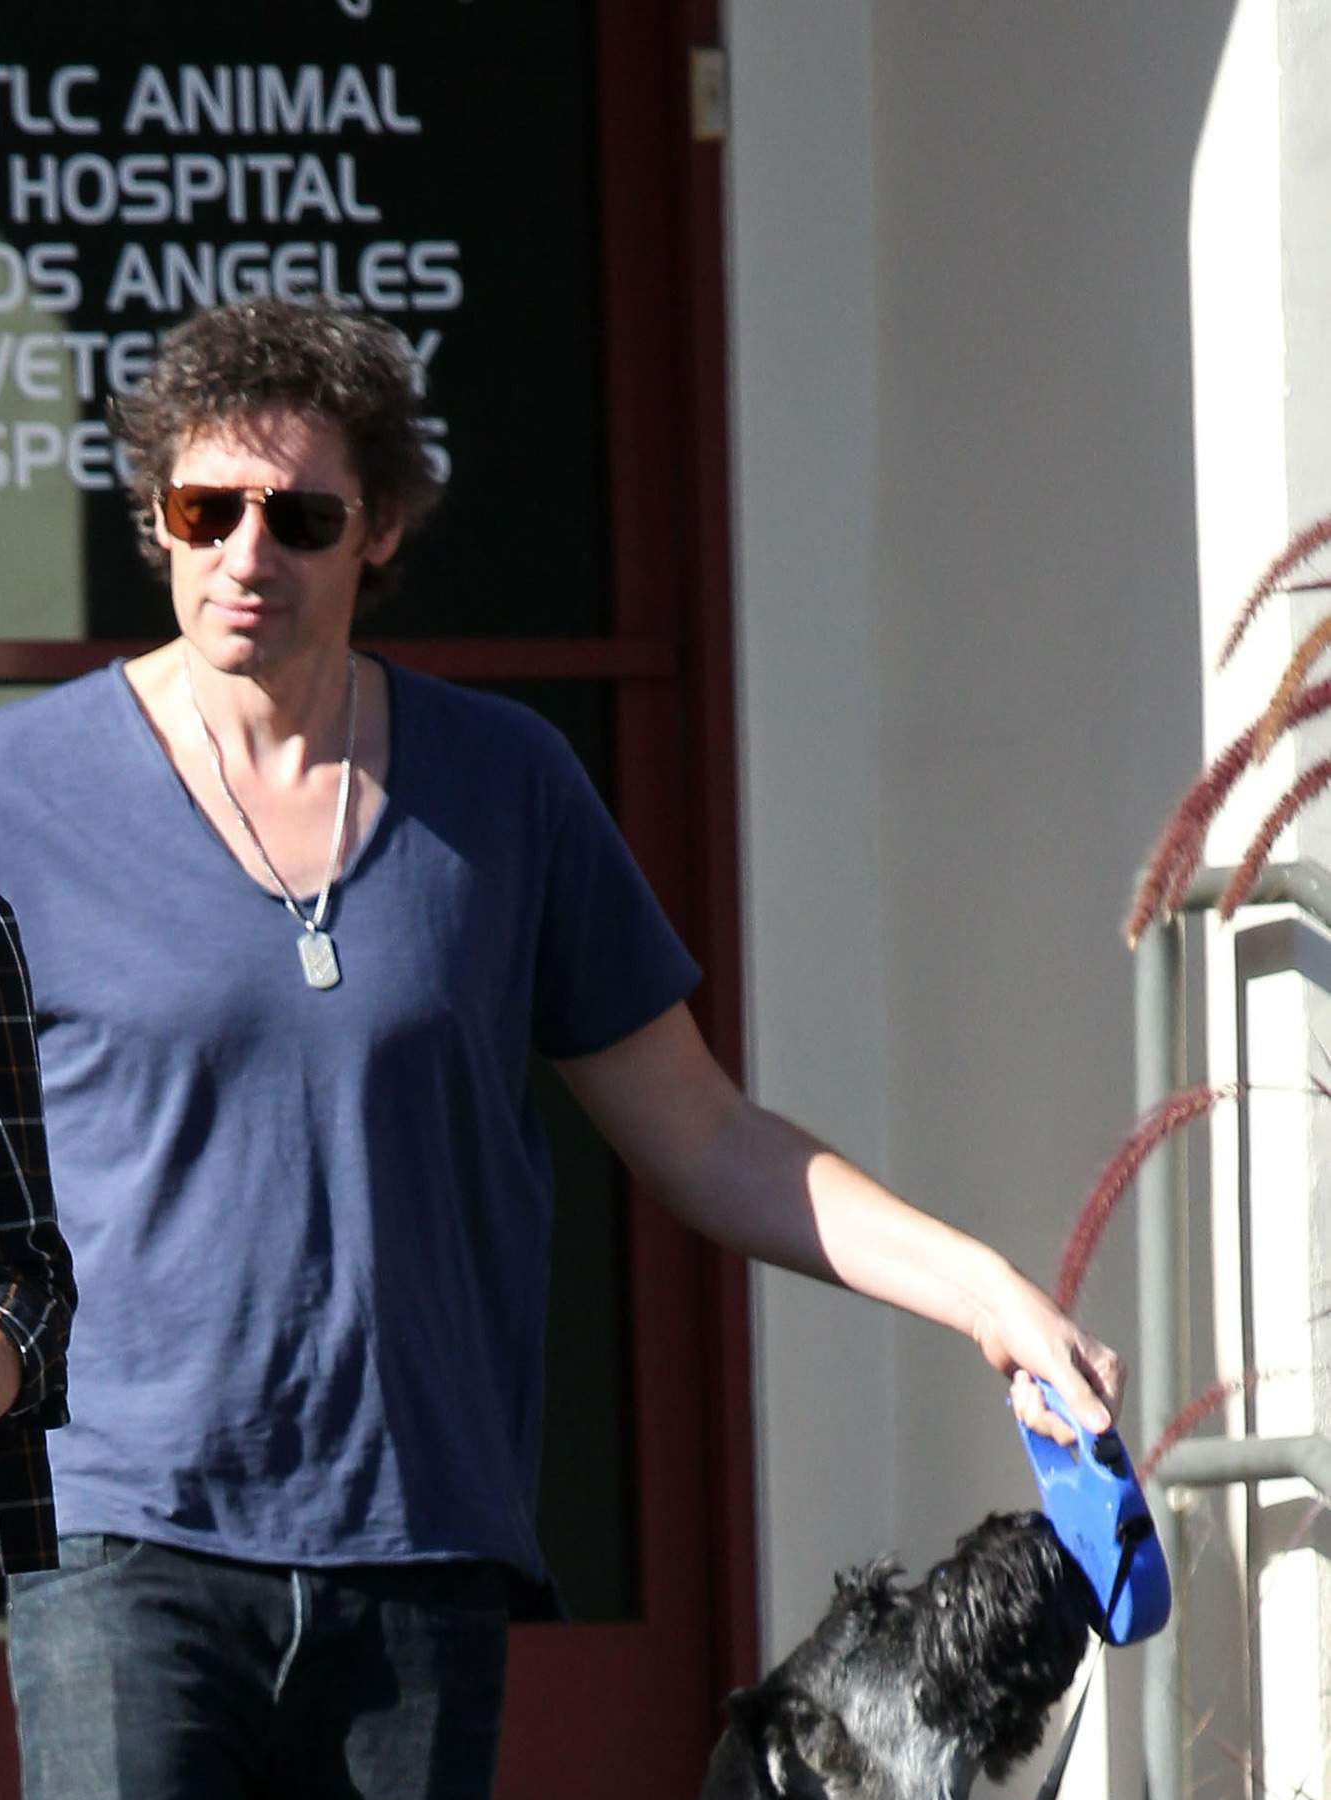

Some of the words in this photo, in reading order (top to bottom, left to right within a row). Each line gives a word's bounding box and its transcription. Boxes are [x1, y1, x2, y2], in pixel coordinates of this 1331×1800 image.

[124, 64, 421, 134] ANIMAL
[7, 153, 382, 225] HOSPITAL
[108, 239, 464, 313] ANGELES
